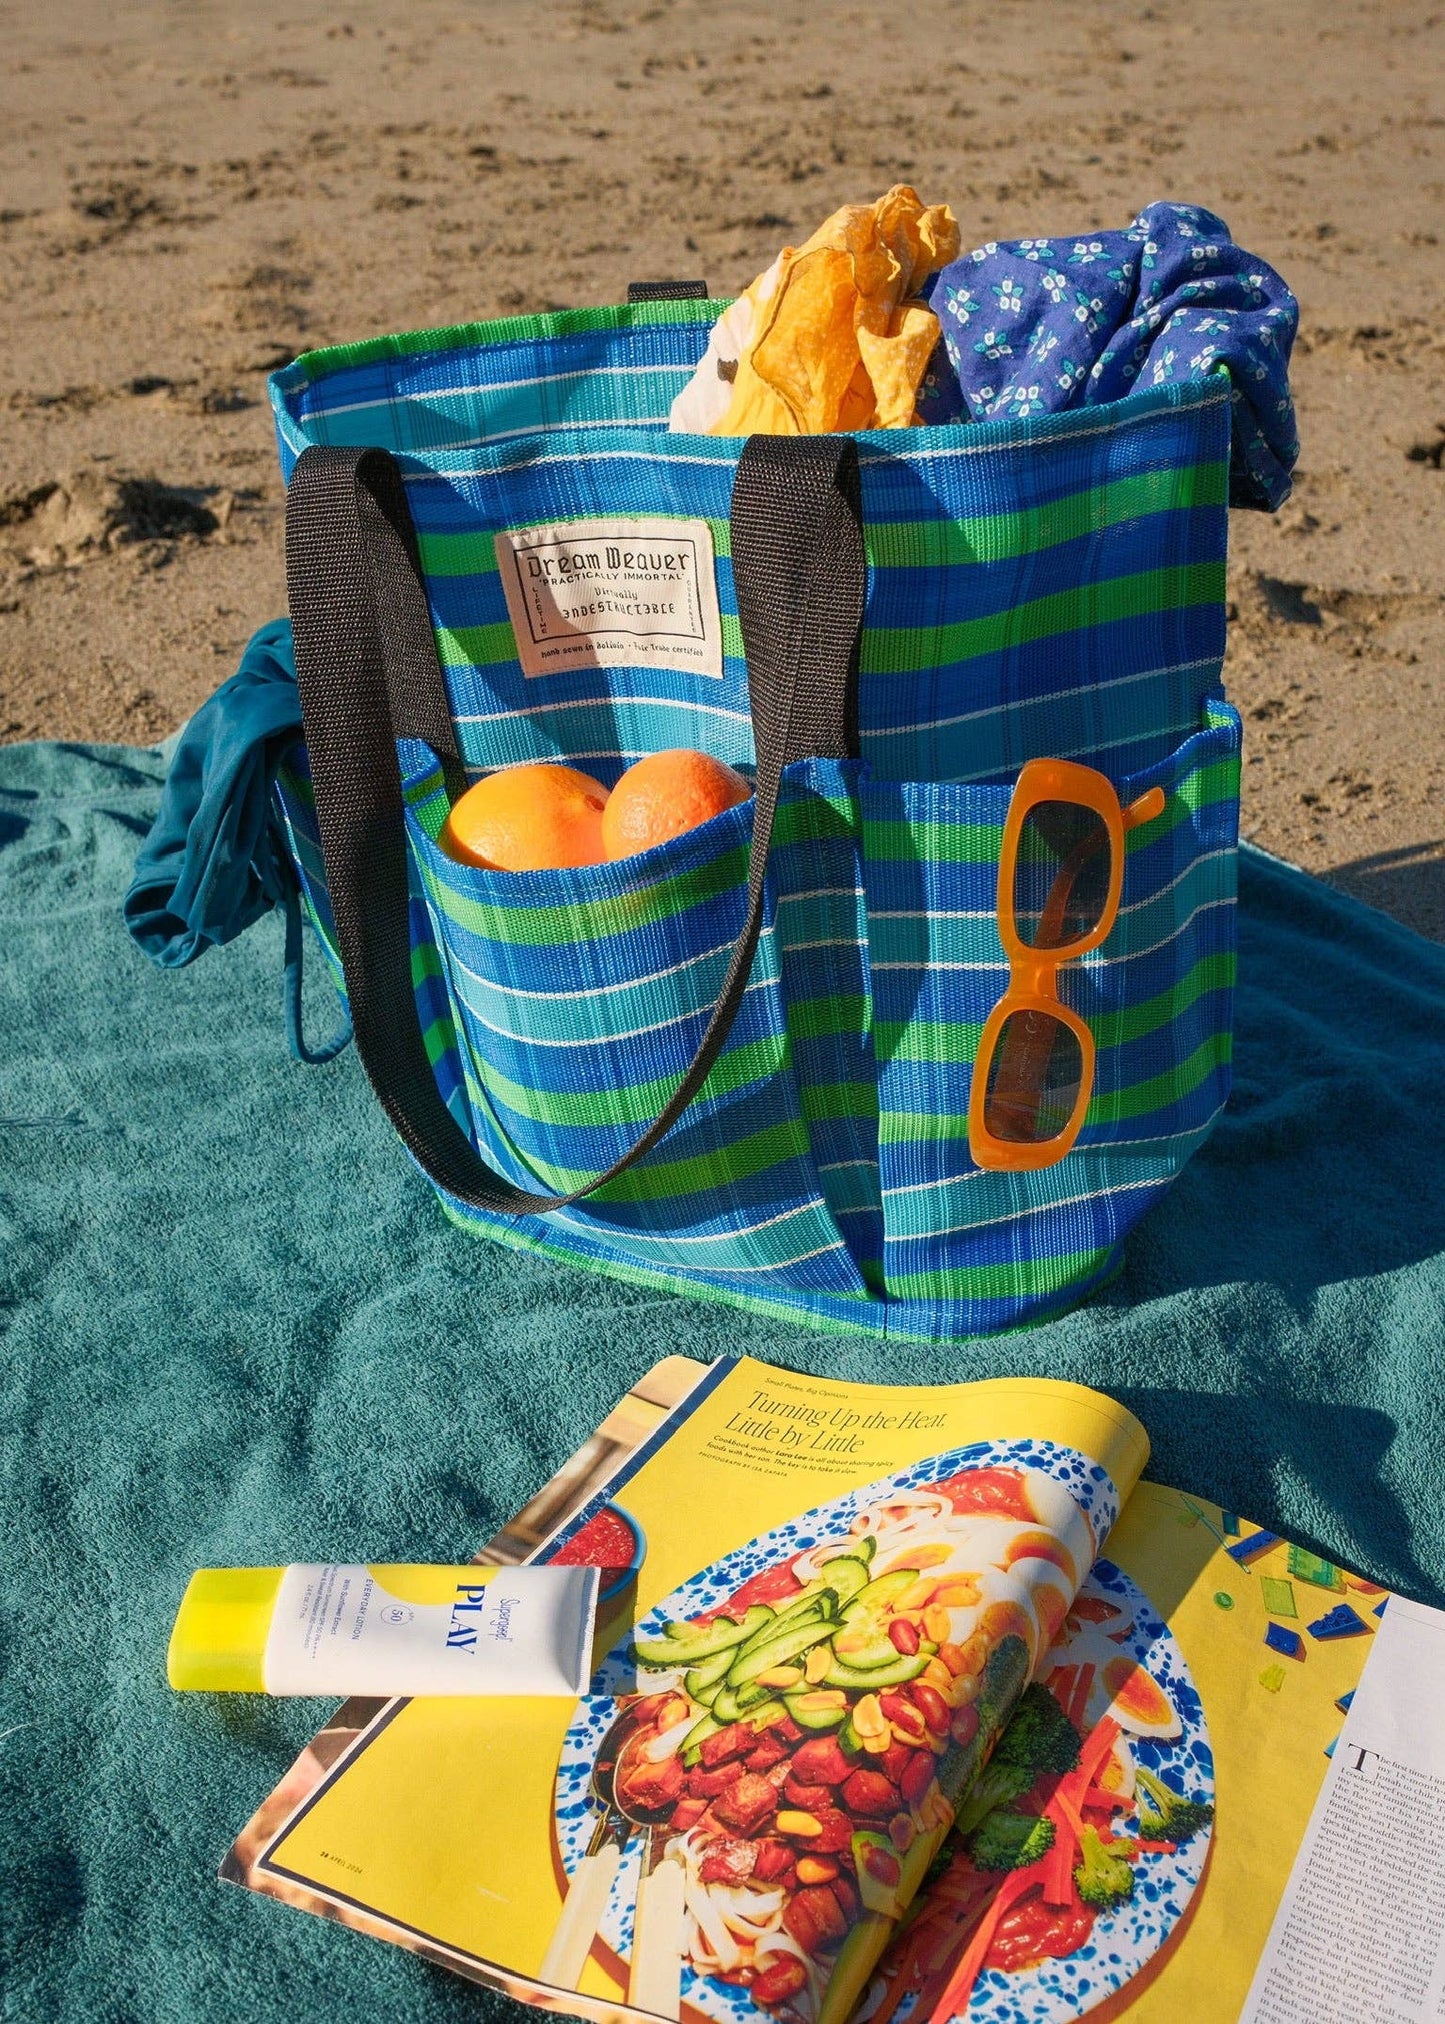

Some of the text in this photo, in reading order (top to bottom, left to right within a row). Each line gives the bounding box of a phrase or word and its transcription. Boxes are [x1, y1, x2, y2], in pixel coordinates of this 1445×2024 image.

[527, 546, 690, 578] Dream Weaver
[594, 586, 638, 600] Virtually
[541, 648, 560, 658] hand
[562, 645, 584, 654] sewn
[585, 643, 594, 652] in
[596, 640, 624, 650] Bolivia
[764, 1378, 784, 1387] Small
[806, 1387, 818, 1396] Big
[819, 1389, 849, 1400] Opinions
[748, 1390, 948, 1432] Turning Up the Heat,
[725, 1412, 864, 1454] Little by Little
[698, 1451, 742, 1467] PHOTOGRAPH
[706, 1442, 727, 1452] foods
[728, 1448, 743, 1456] with
[744, 1452, 756, 1460] her
[774, 1458, 786, 1466] The
[787, 1461, 800, 1470] key
[714, 1434, 750, 1449] Cookbook
[750, 1445, 774, 1454] author
[776, 1450, 792, 1459] Lara
[794, 1452, 808, 1460] Lee
[848, 1460, 876, 1468] sharing
[330, 1578, 351, 1636] With Sunflower Extract
[352, 1578, 374, 1640] EVERYDAY LOTION
[390, 1609, 402, 1622] 50
[446, 1584, 486, 1654] PLAY
